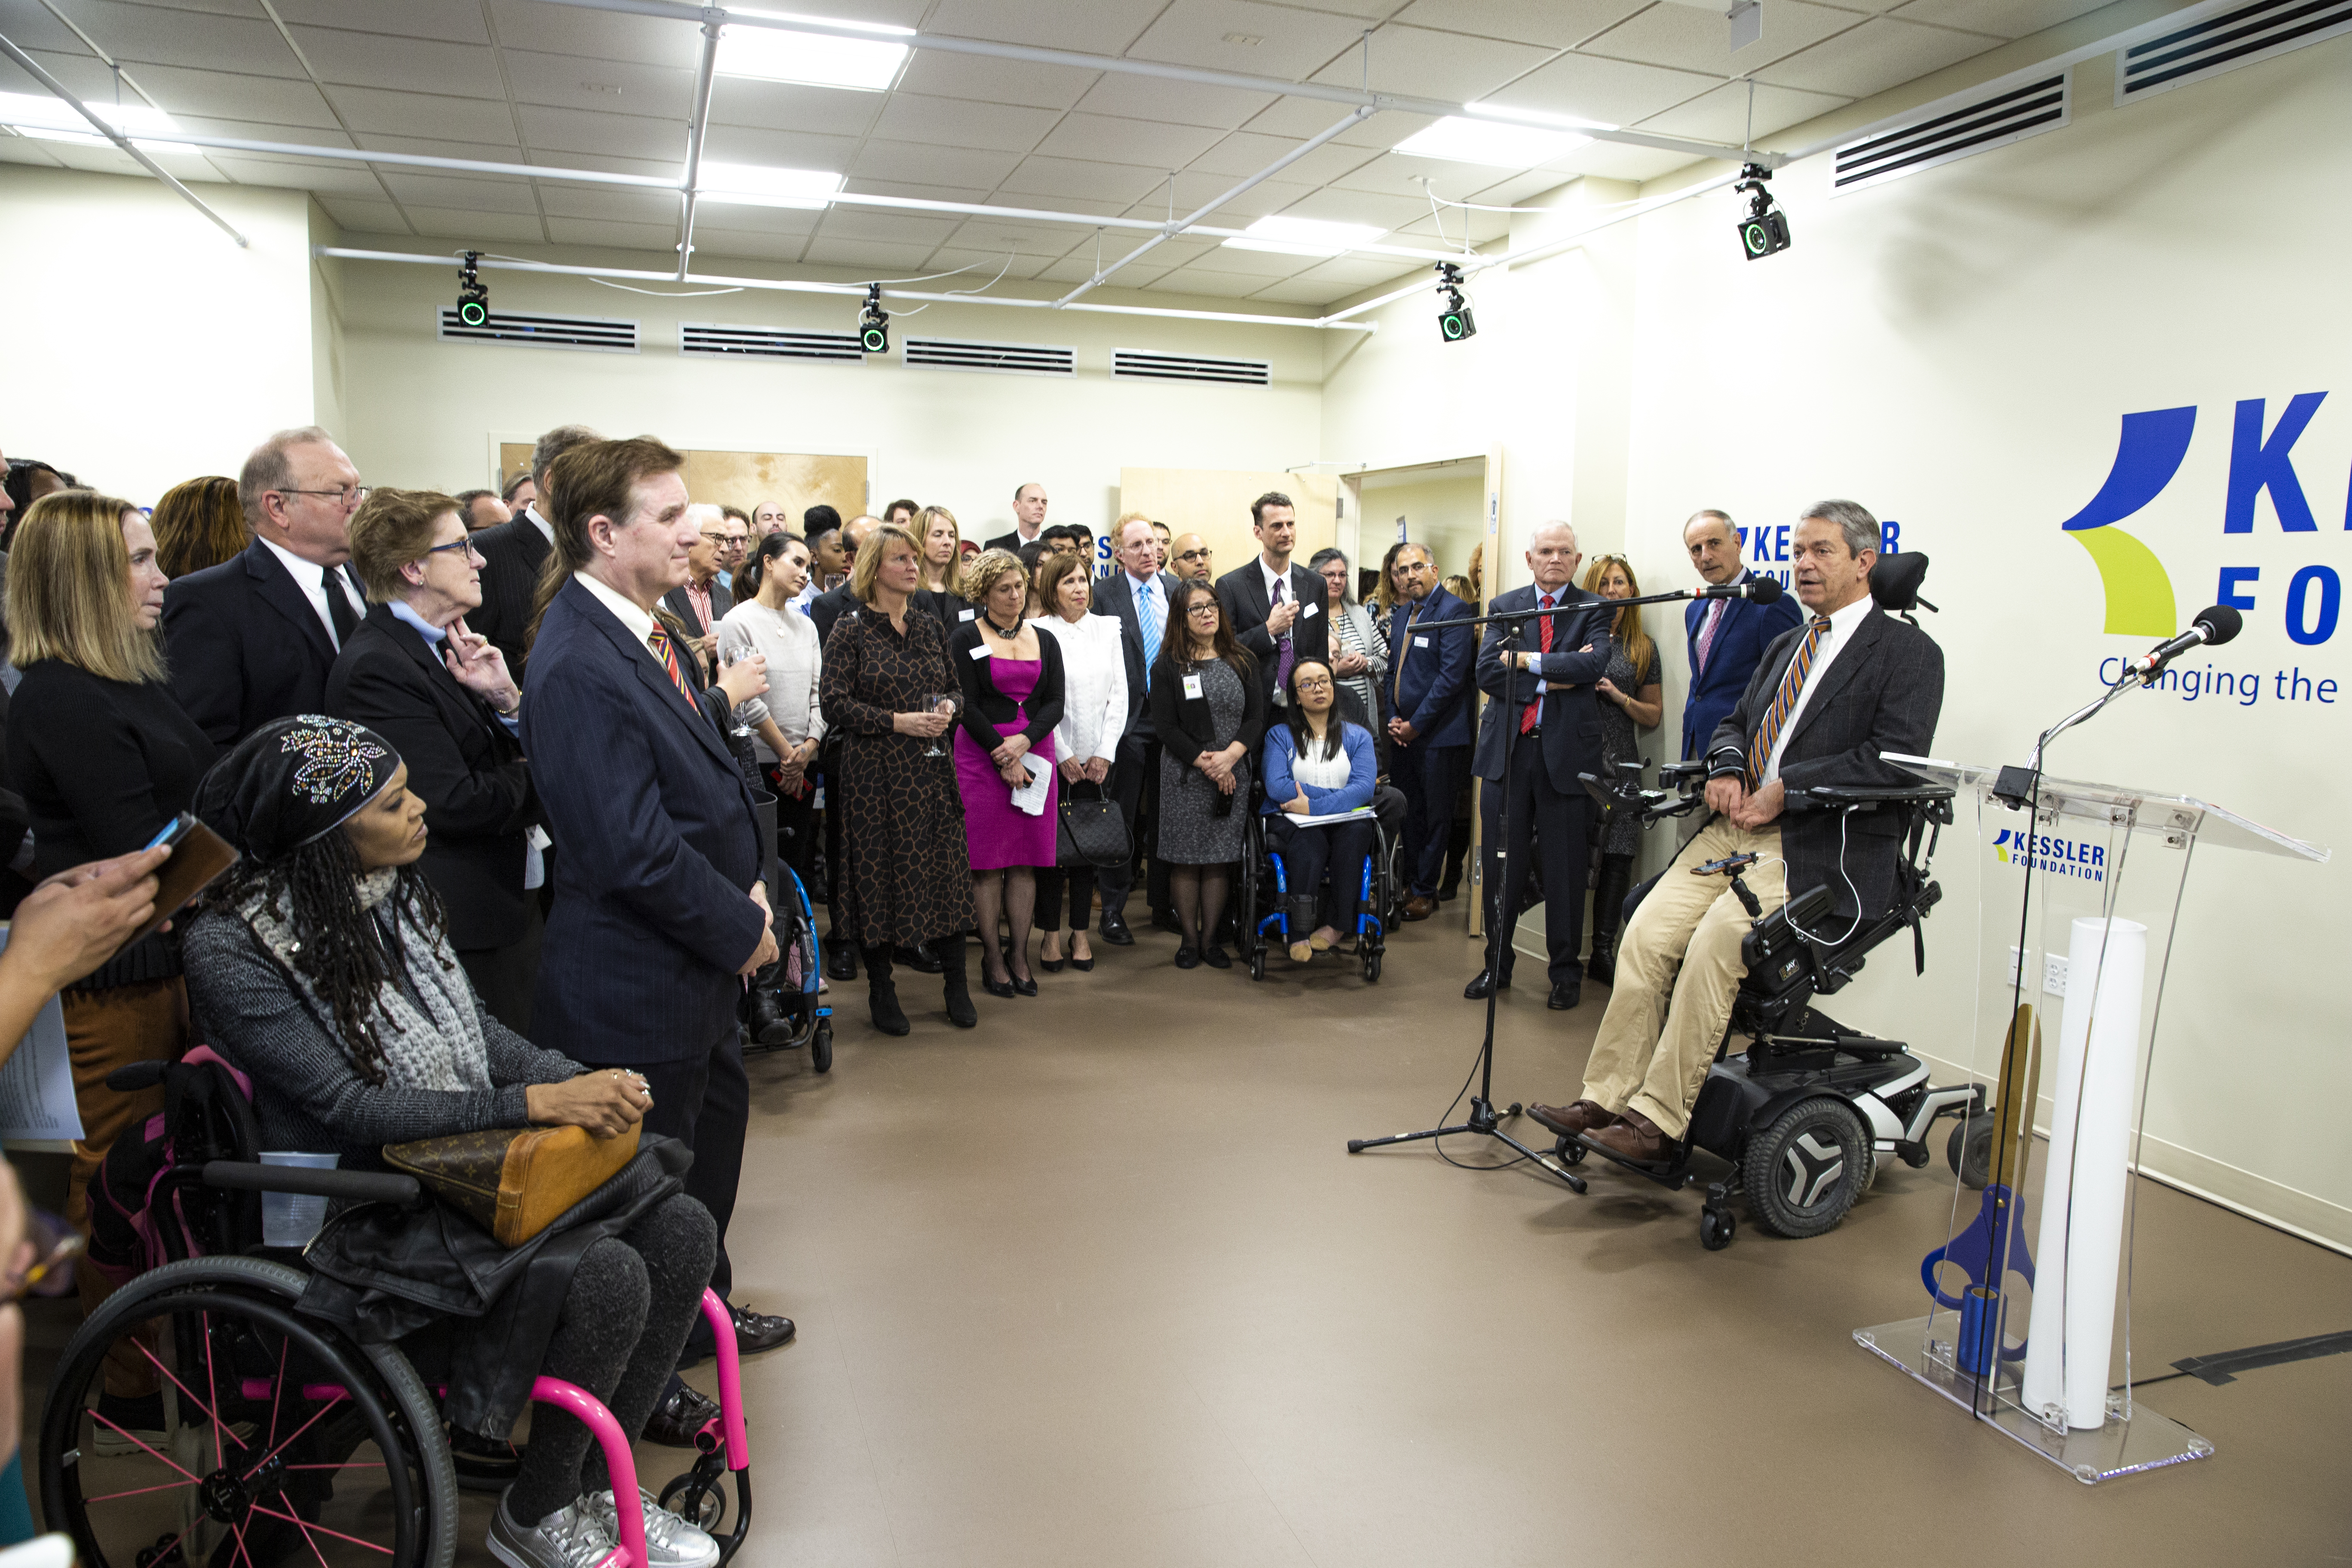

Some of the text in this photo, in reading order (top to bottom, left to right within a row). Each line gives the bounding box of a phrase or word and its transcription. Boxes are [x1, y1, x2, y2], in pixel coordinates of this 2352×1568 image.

[2275, 667, 2338, 703] the
[2014, 831, 2104, 866] KESSLER
[2012, 854, 2102, 882] FOUNDATION
